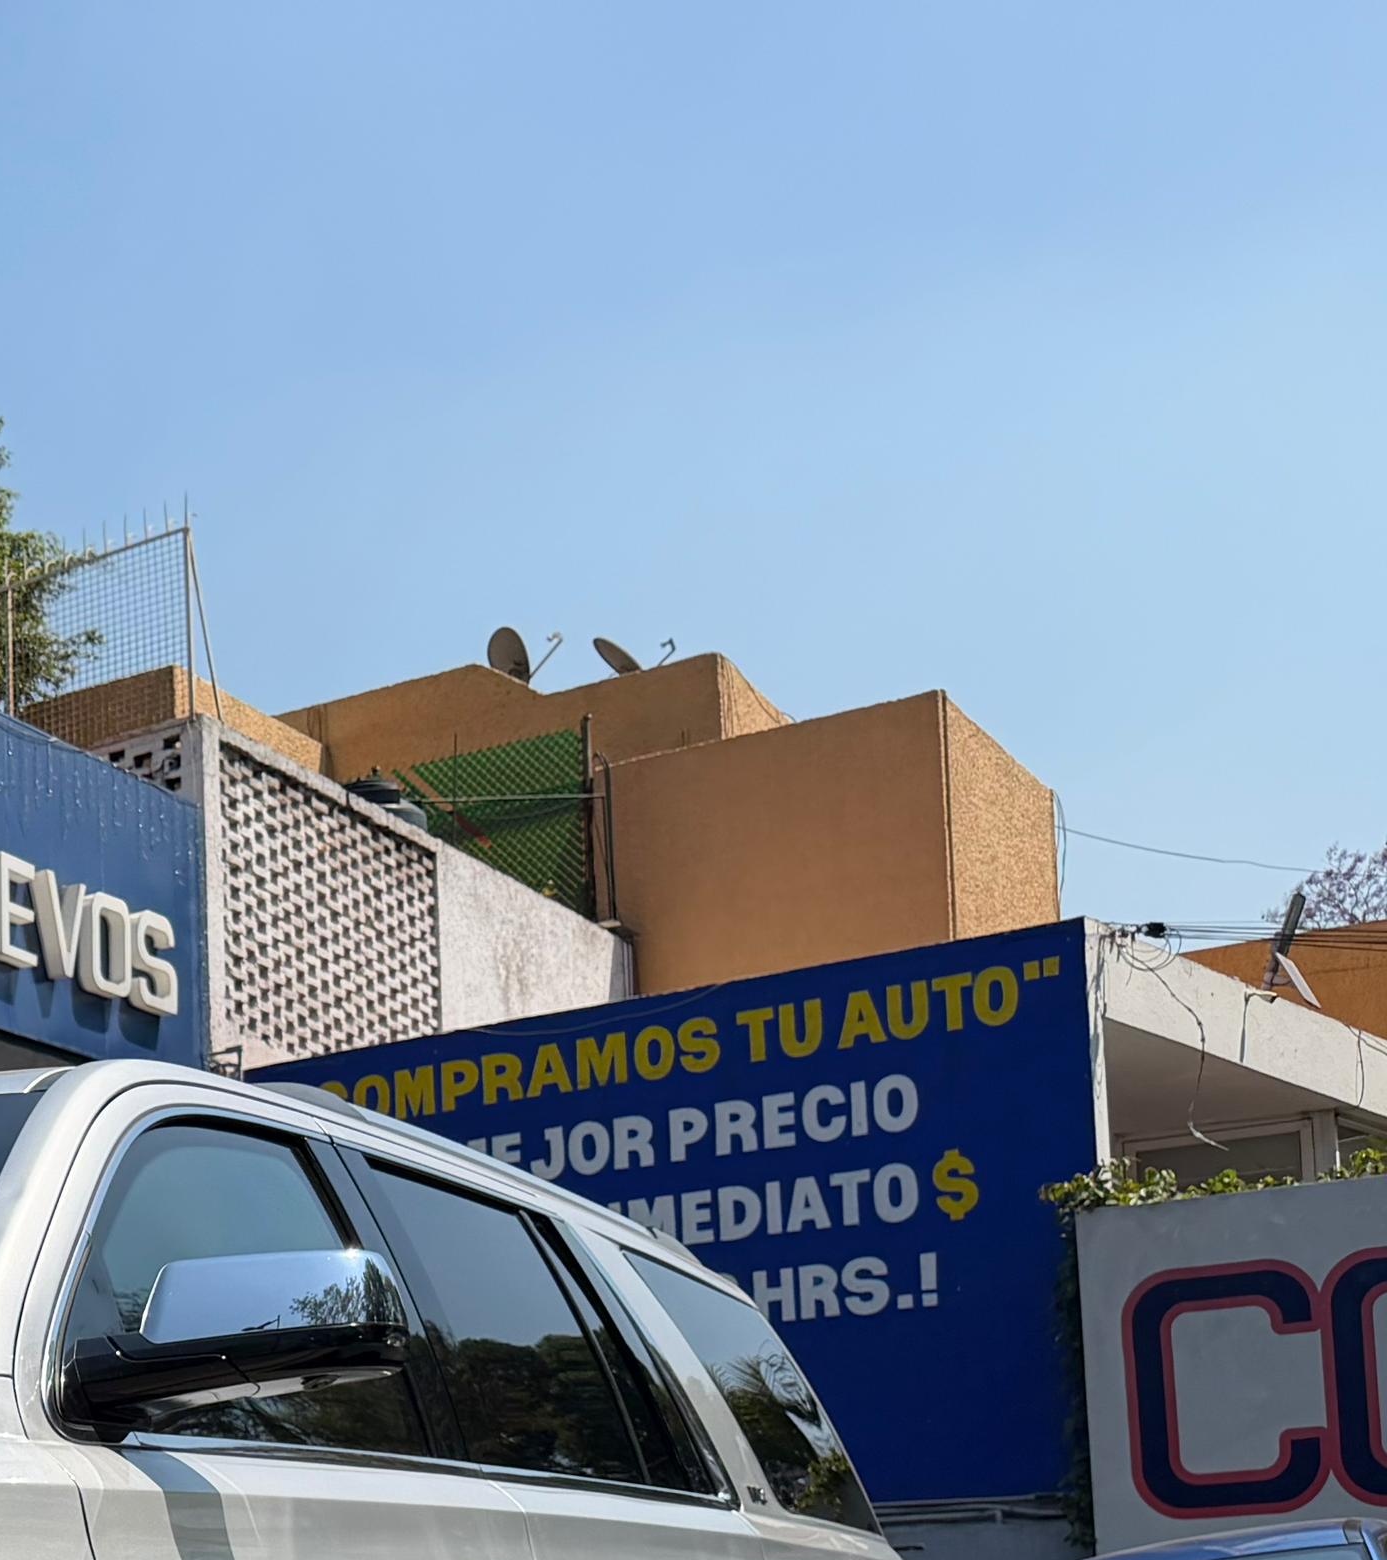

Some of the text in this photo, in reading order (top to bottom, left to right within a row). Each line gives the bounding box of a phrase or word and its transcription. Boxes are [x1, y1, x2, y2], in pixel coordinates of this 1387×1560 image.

[736, 998, 824, 1061] TU
[470, 1074, 919, 1180] EJOR PRECIO
[608, 1148, 979, 1245] MEDIATO $
[751, 1252, 939, 1322] HRS.!
